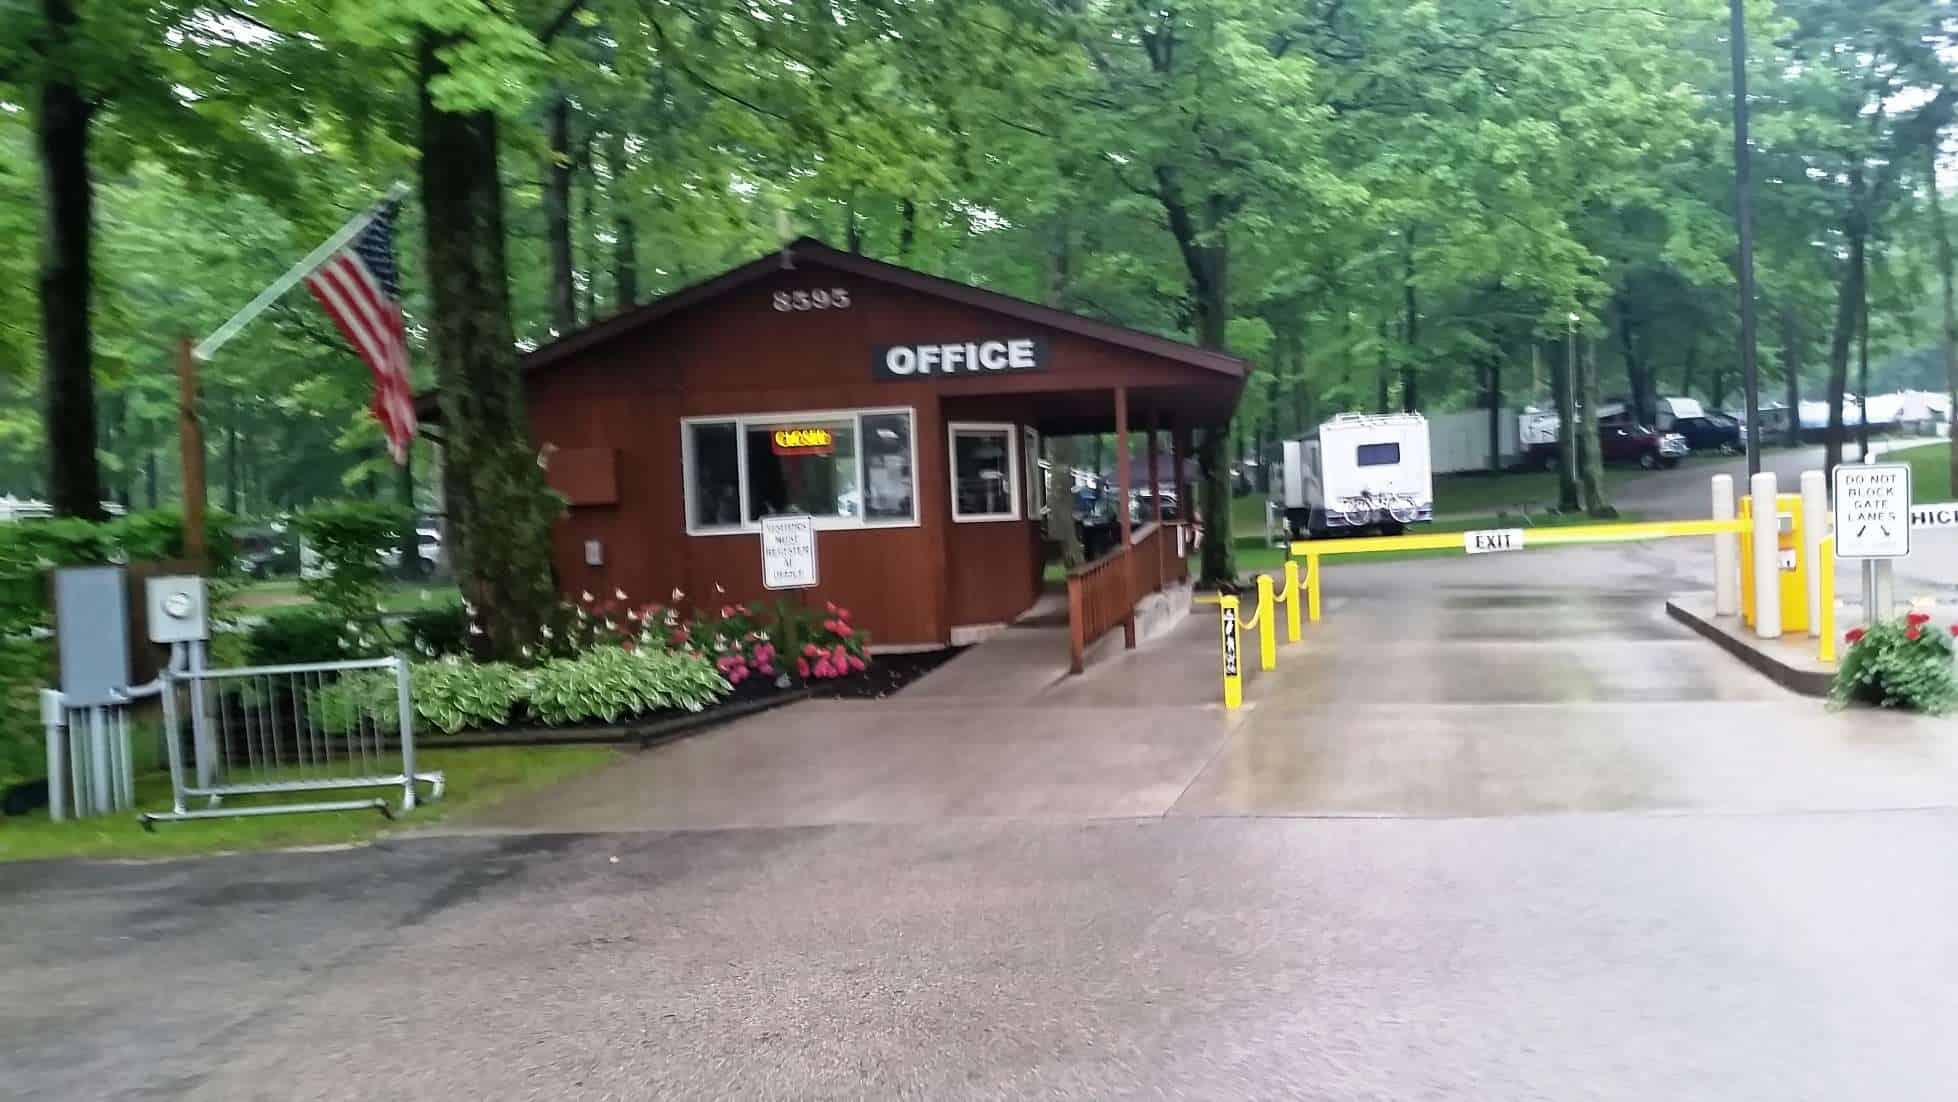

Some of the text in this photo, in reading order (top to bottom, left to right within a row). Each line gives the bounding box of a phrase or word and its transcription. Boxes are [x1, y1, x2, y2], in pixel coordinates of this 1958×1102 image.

[886, 338, 1036, 375] OFFICE
[1846, 474, 1896, 485] DO NOT
[1848, 487, 1894, 497] BLOCK
[1854, 500, 1888, 510] GATE
[1848, 512, 1896, 521] LANES
[1475, 534, 1511, 549] EXIT
